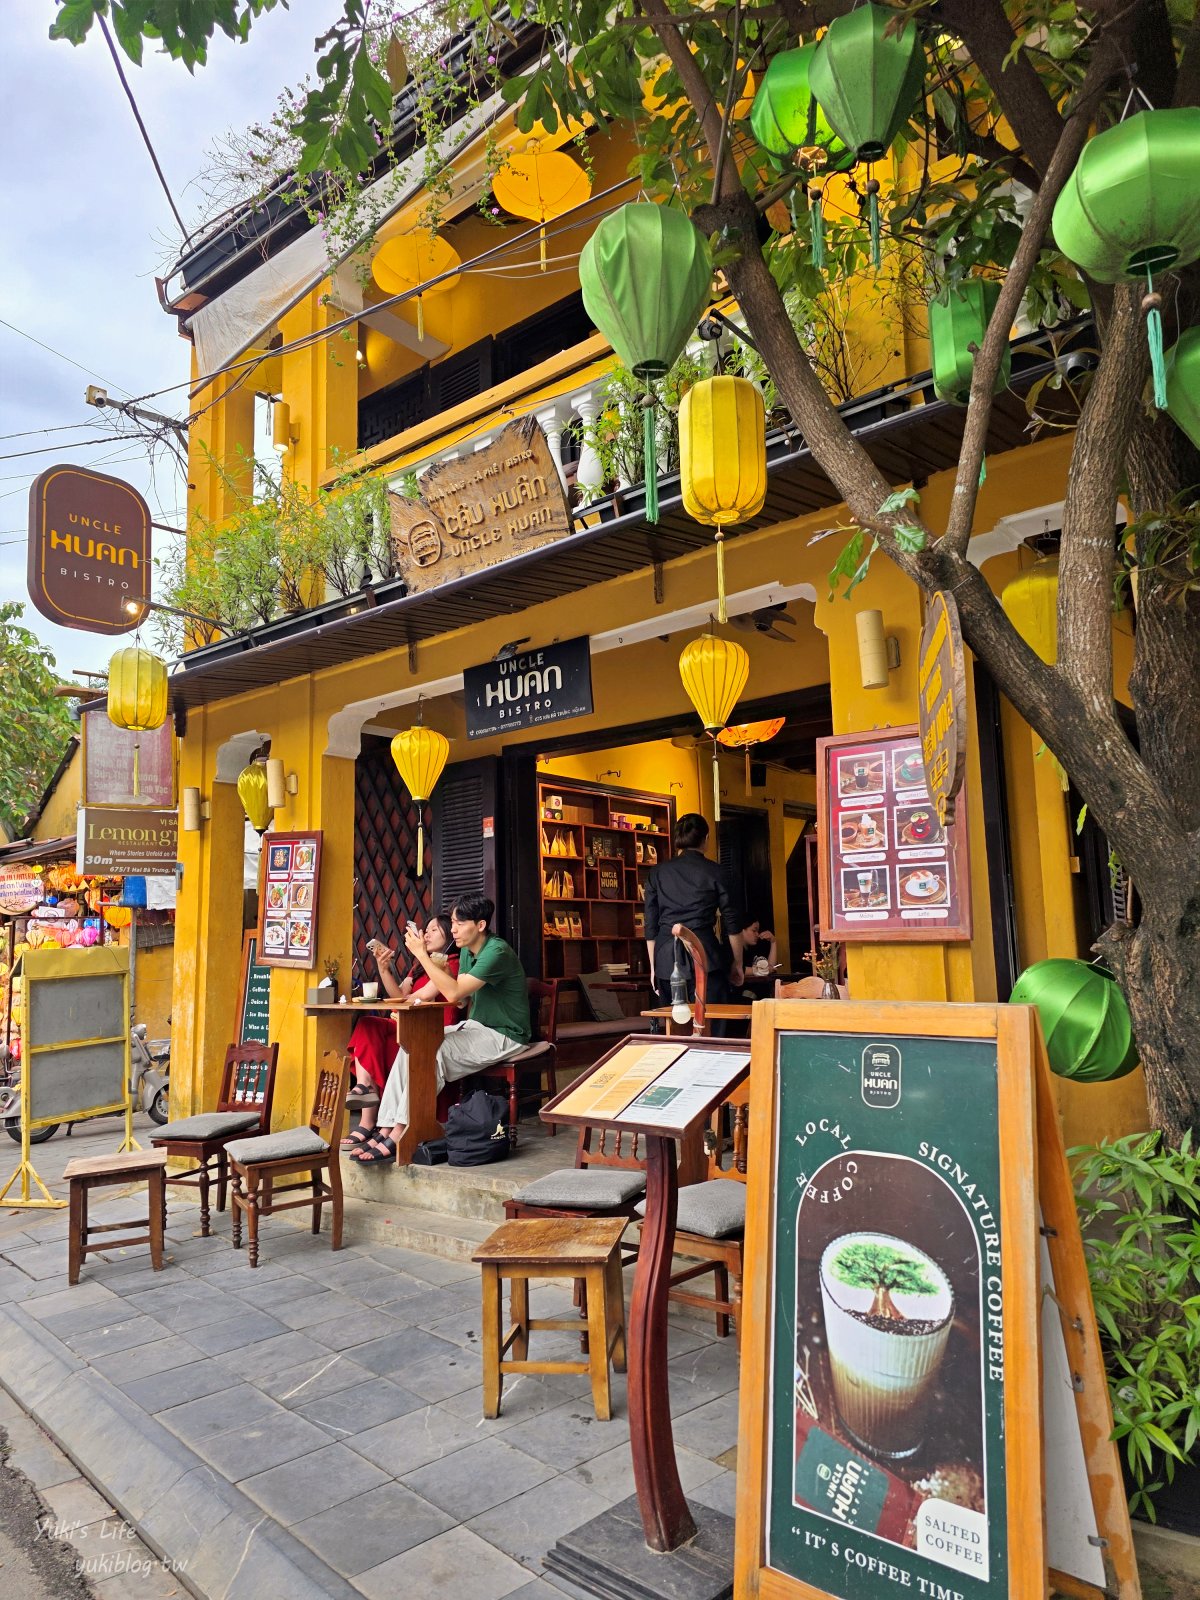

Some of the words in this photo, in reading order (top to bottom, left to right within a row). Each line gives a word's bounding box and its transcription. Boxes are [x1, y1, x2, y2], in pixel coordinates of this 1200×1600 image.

[69, 512, 122, 535] UNCLE
[451, 528, 502, 557] UNCLE
[507, 506, 553, 536] HUAN
[50, 529, 138, 569] HUAN
[60, 567, 129, 590] BISTRO
[500, 652, 545, 675] UNCLE
[485, 665, 562, 707] HUAN
[499, 699, 552, 719] BISTRO
[85, 855, 112, 865] 30m
[864, 1078, 898, 1090] HUAN
[795, 1118, 852, 1150] LOCAL
[795, 1160, 858, 1204] COFFEE
[918, 1141, 1002, 1267] SIGNATURE
[987, 1275, 1004, 1382] COFFEE
[826, 1463, 844, 1498] UNCLE
[831, 1460, 862, 1521] HUAN
[924, 1514, 981, 1545] SALTED
[925, 1533, 983, 1565] COFFEE
[844, 1548, 911, 1587] COFFEE
[916, 1575, 965, 1600] TIME
